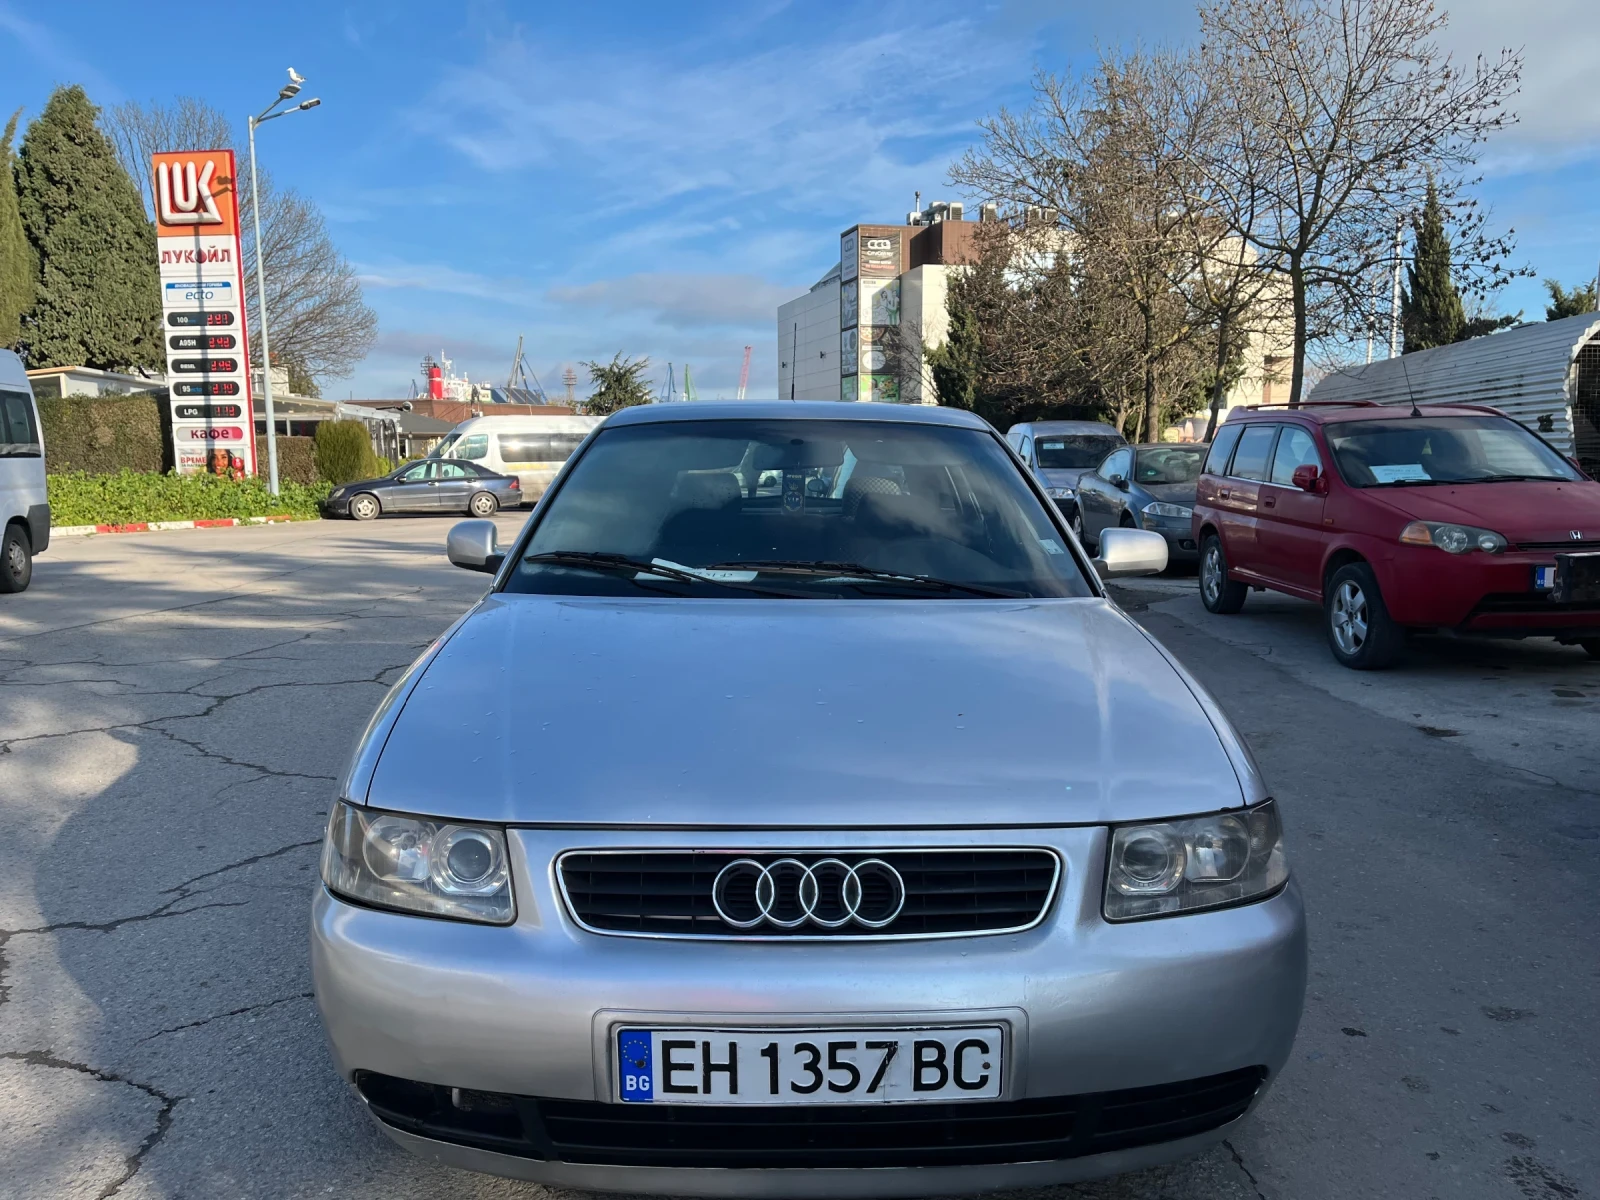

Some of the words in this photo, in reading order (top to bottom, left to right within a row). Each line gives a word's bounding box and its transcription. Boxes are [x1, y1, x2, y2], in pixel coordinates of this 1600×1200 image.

[161, 245, 231, 264] ЛУКОЙЛ
[185, 289, 214, 300] ecto
[183, 408, 199, 416] LPG
[190, 428, 230, 440] кафе
[625, 1075, 650, 1091] BG
[661, 1040, 738, 1095] EH
[760, 1040, 899, 1095] 1357
[912, 1038, 990, 1092] BC
